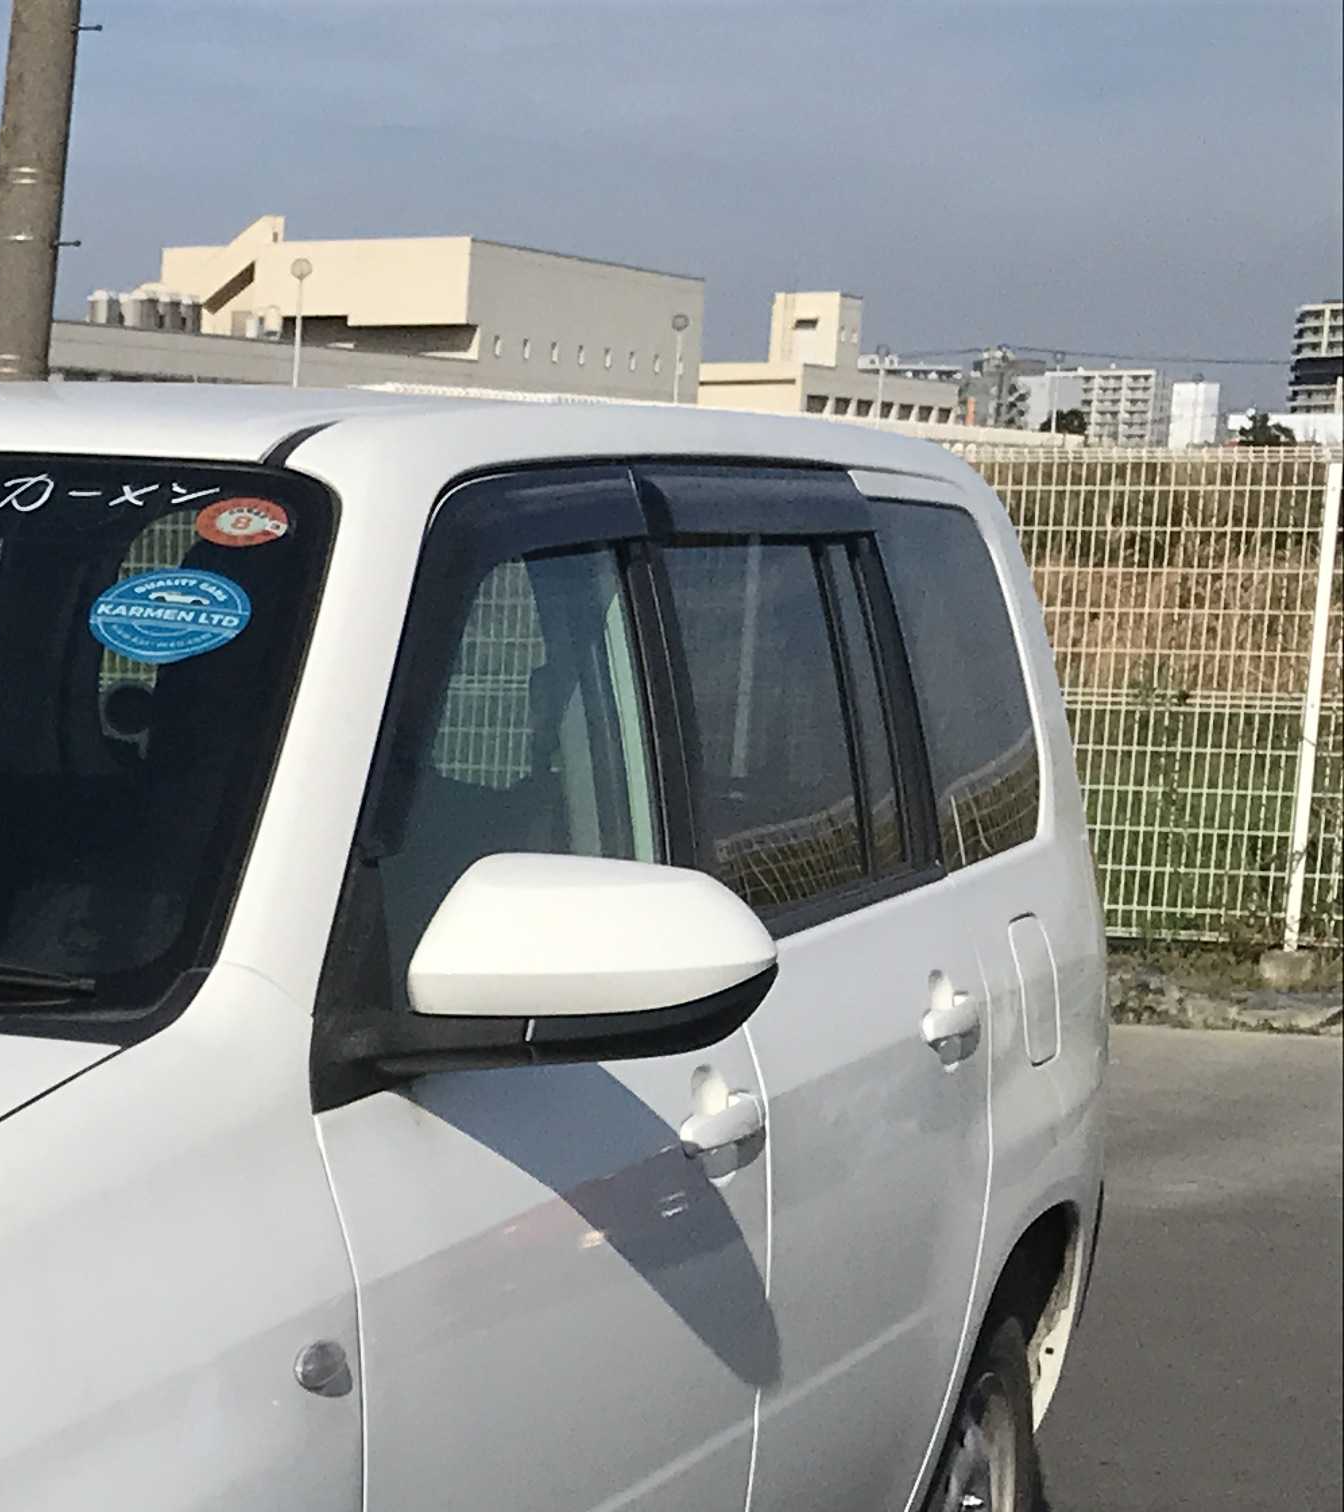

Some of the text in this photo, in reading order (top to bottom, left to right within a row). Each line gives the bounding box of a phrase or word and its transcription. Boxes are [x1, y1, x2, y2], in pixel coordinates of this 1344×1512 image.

[133, 578, 198, 594] QUALITY
[96, 602, 240, 628] KARMEN LTD
